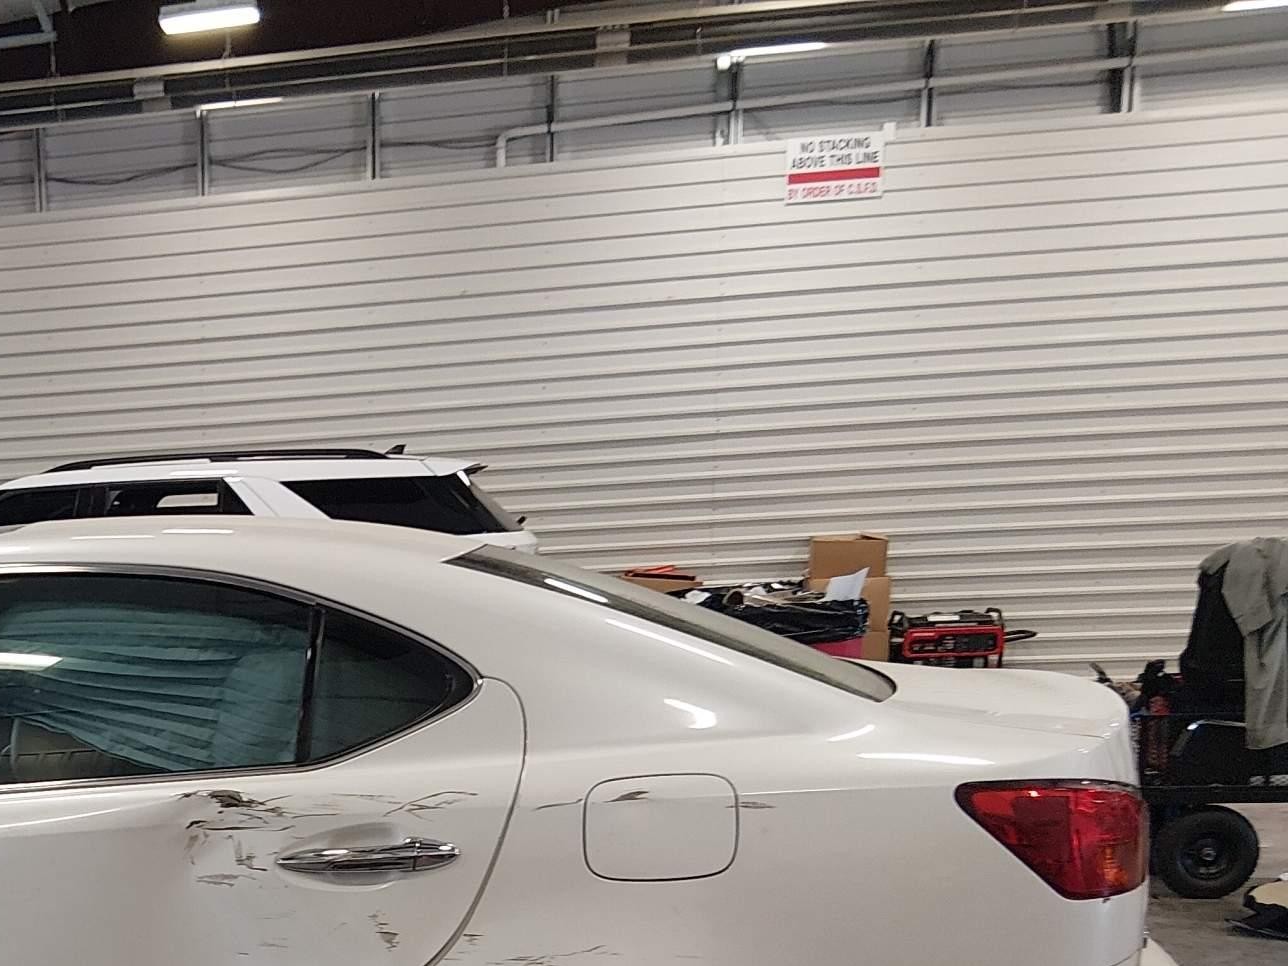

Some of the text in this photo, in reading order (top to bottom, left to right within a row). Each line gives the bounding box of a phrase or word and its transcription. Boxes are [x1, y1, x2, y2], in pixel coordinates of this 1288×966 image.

[800, 136, 871, 154] NO STACKING
[792, 150, 880, 169] ABOVE THIS LINE
[787, 188, 798, 200] BY
[801, 185, 830, 199] ORDER
[834, 184, 846, 196] OF
